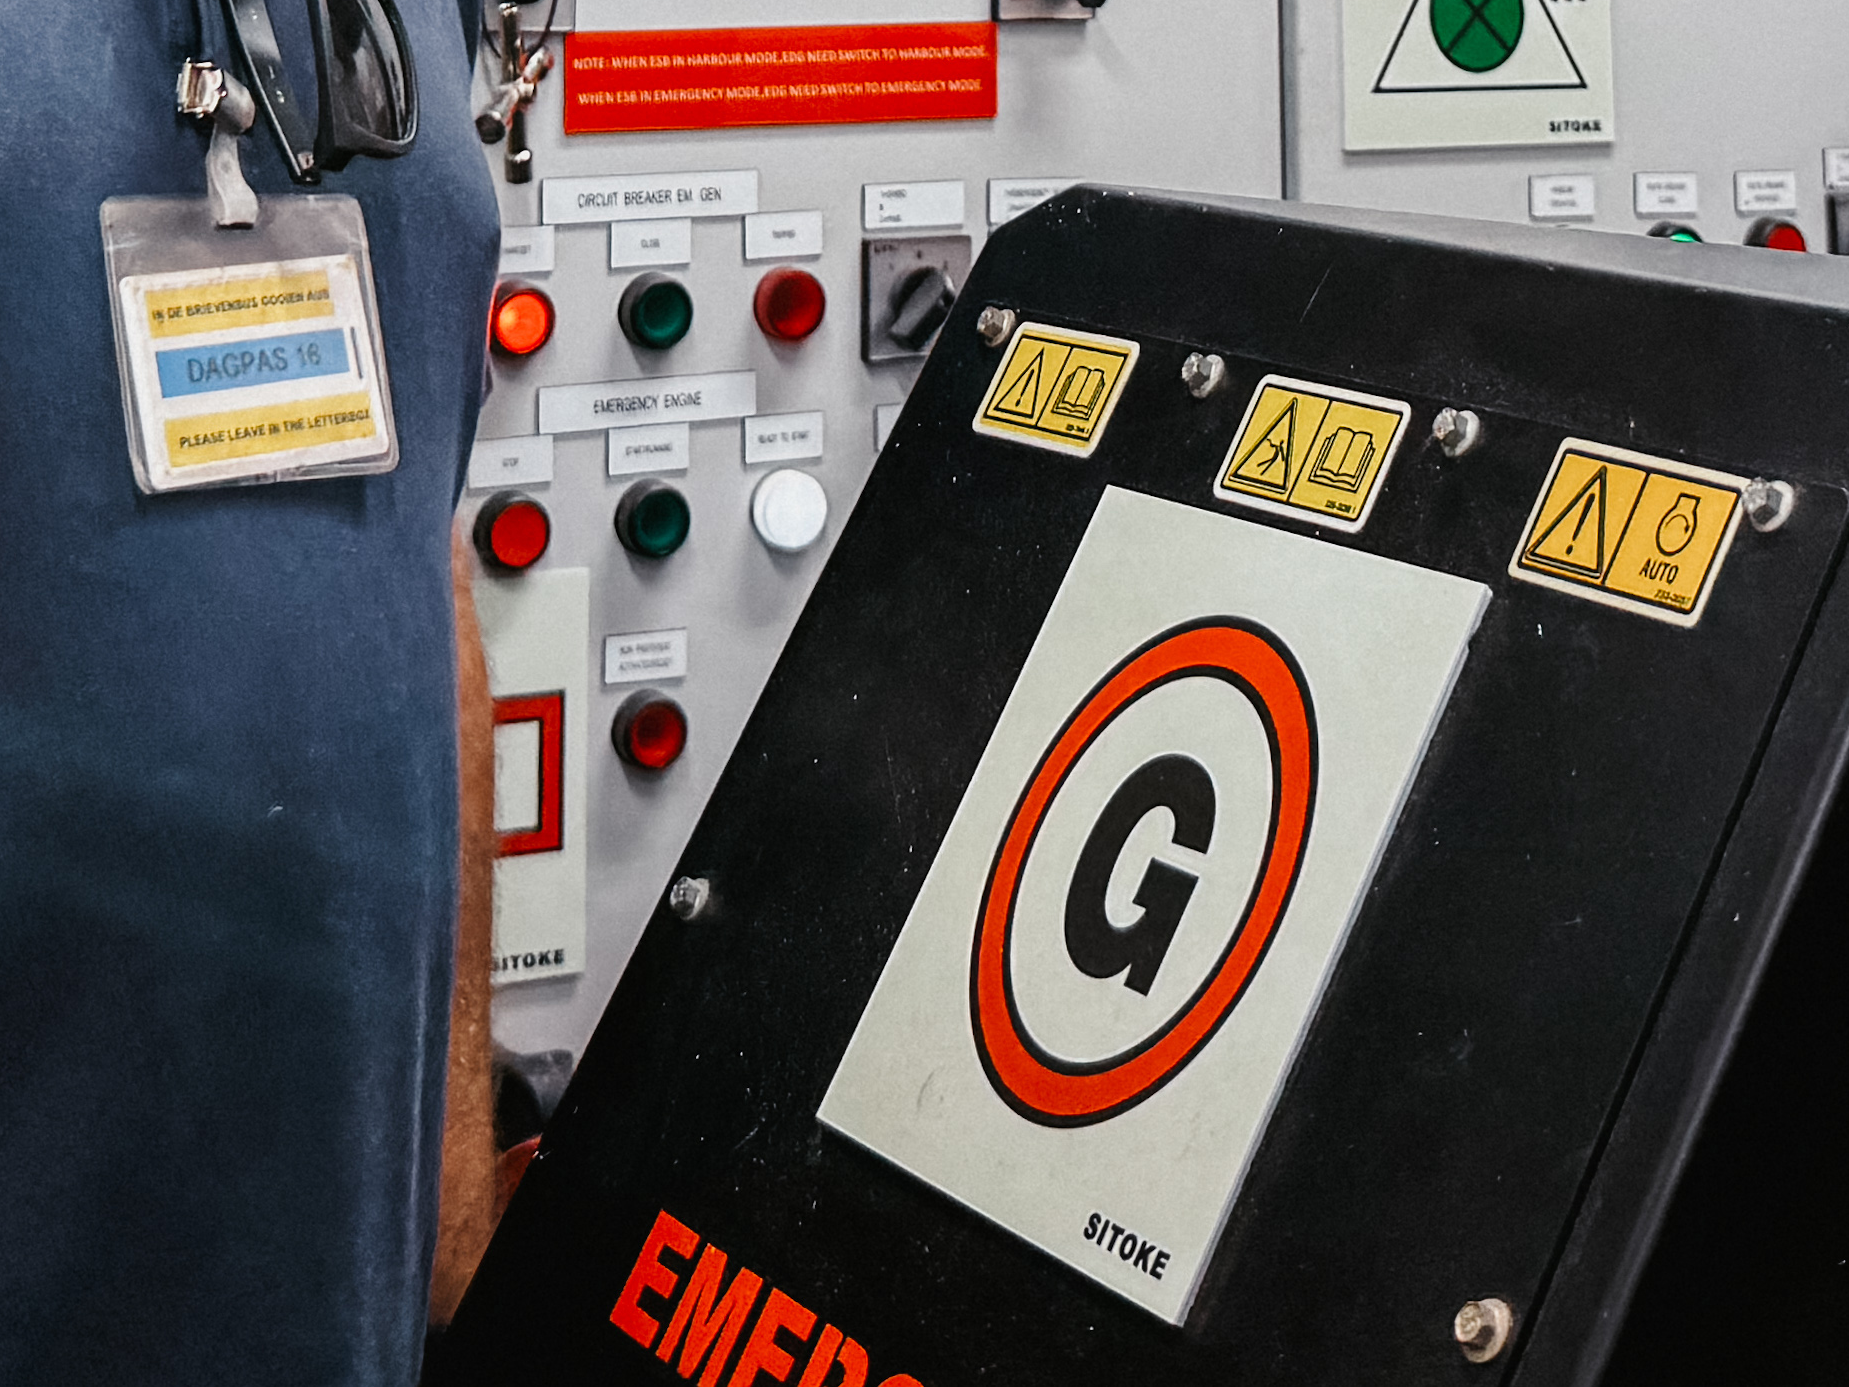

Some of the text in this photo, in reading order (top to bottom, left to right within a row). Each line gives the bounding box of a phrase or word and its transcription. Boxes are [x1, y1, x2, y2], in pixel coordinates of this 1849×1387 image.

[673, 54, 685, 67] IN
[882, 47, 898, 61] TO
[640, 89, 651, 103] IN
[578, 192, 618, 208] CIRCUIT
[624, 189, 672, 206] BREAKER
[700, 186, 722, 202] GEN
[168, 305, 184, 319] DE
[187, 346, 288, 384] DAGPAS
[593, 391, 702, 414] EMERGENCY ENGINE
[179, 428, 225, 449] PLEASE
[227, 423, 266, 441] LEAVE
[1639, 558, 1679, 585] AUTO
[1064, 753, 1217, 997] G
[1083, 1212, 1171, 1280] SITOKE
[609, 1209, 926, 1387] EMER
